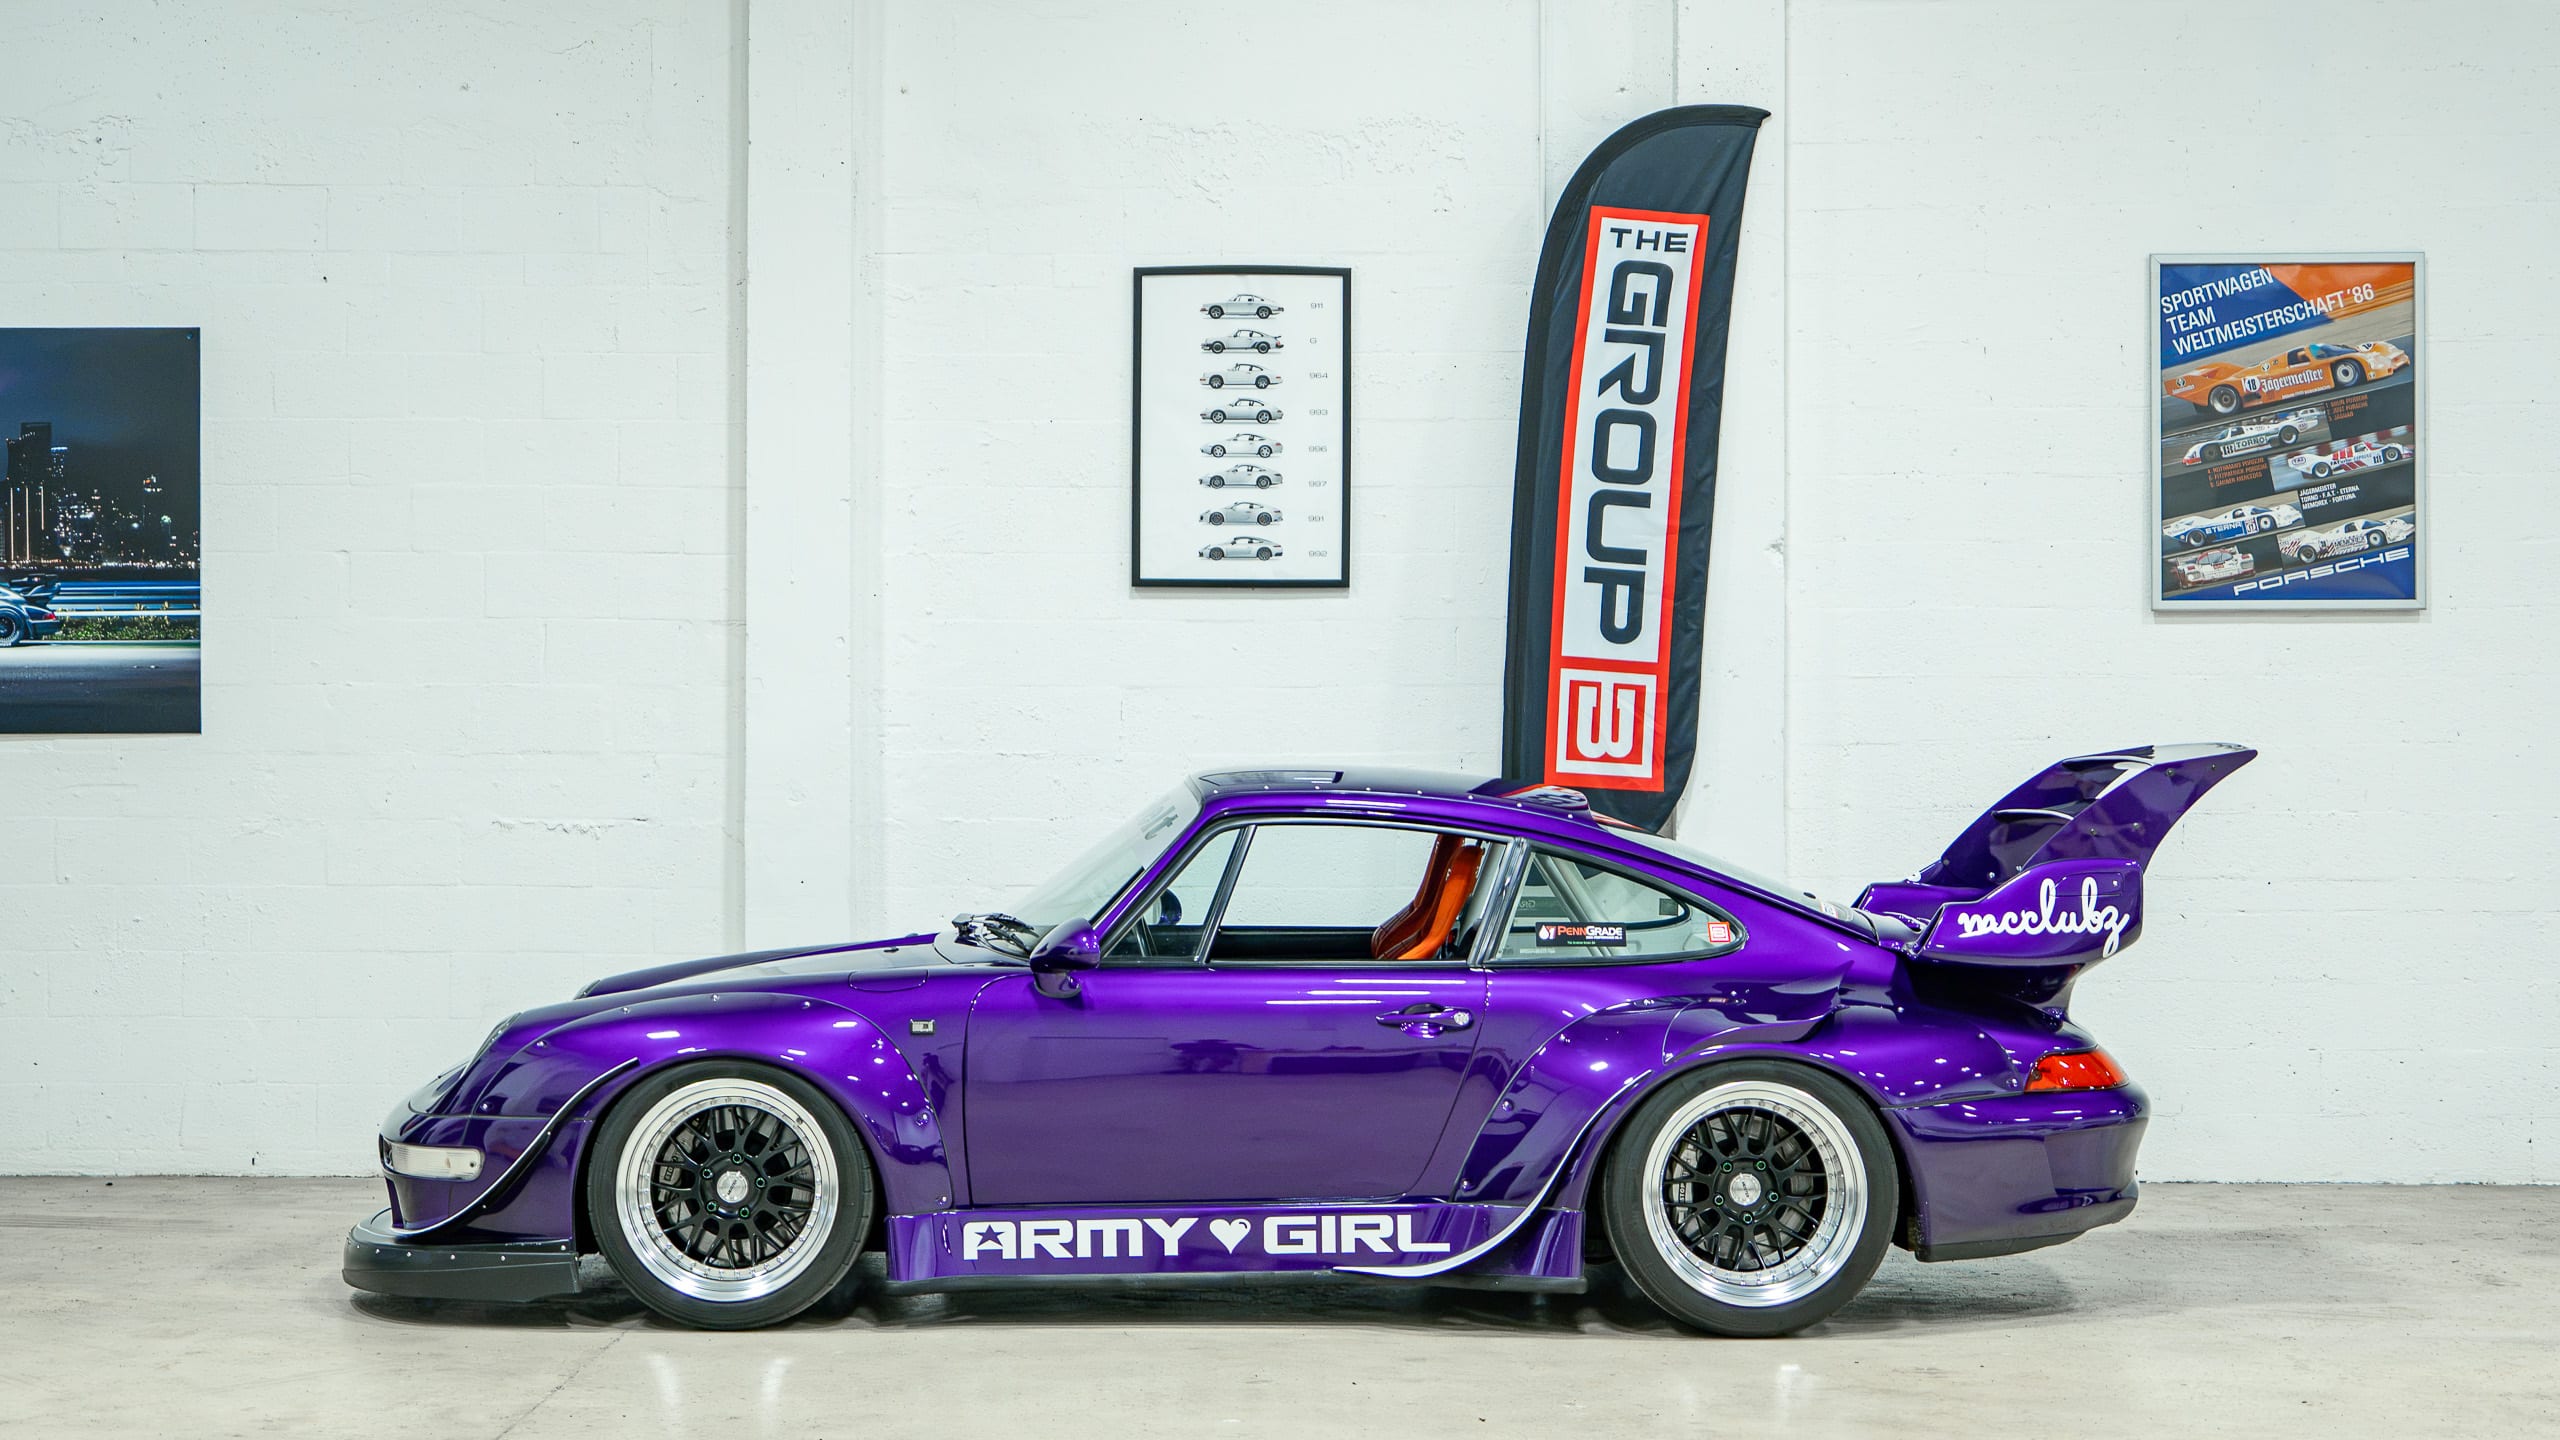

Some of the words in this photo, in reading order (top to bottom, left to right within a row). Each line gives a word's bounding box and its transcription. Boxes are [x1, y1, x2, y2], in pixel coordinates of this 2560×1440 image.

[1610, 227, 1689, 253] THE
[2161, 267, 2274, 314] SPORTWAGEN
[2166, 306, 2217, 334] TEAM
[2172, 291, 2346, 355] WELTMEISTERSCHAFT
[1583, 259, 1674, 645] GROUP
[2233, 547, 2410, 596] PORSCHE
[963, 1217, 1199, 1260] ARMY
[1263, 1214, 1450, 1255] GIRL
